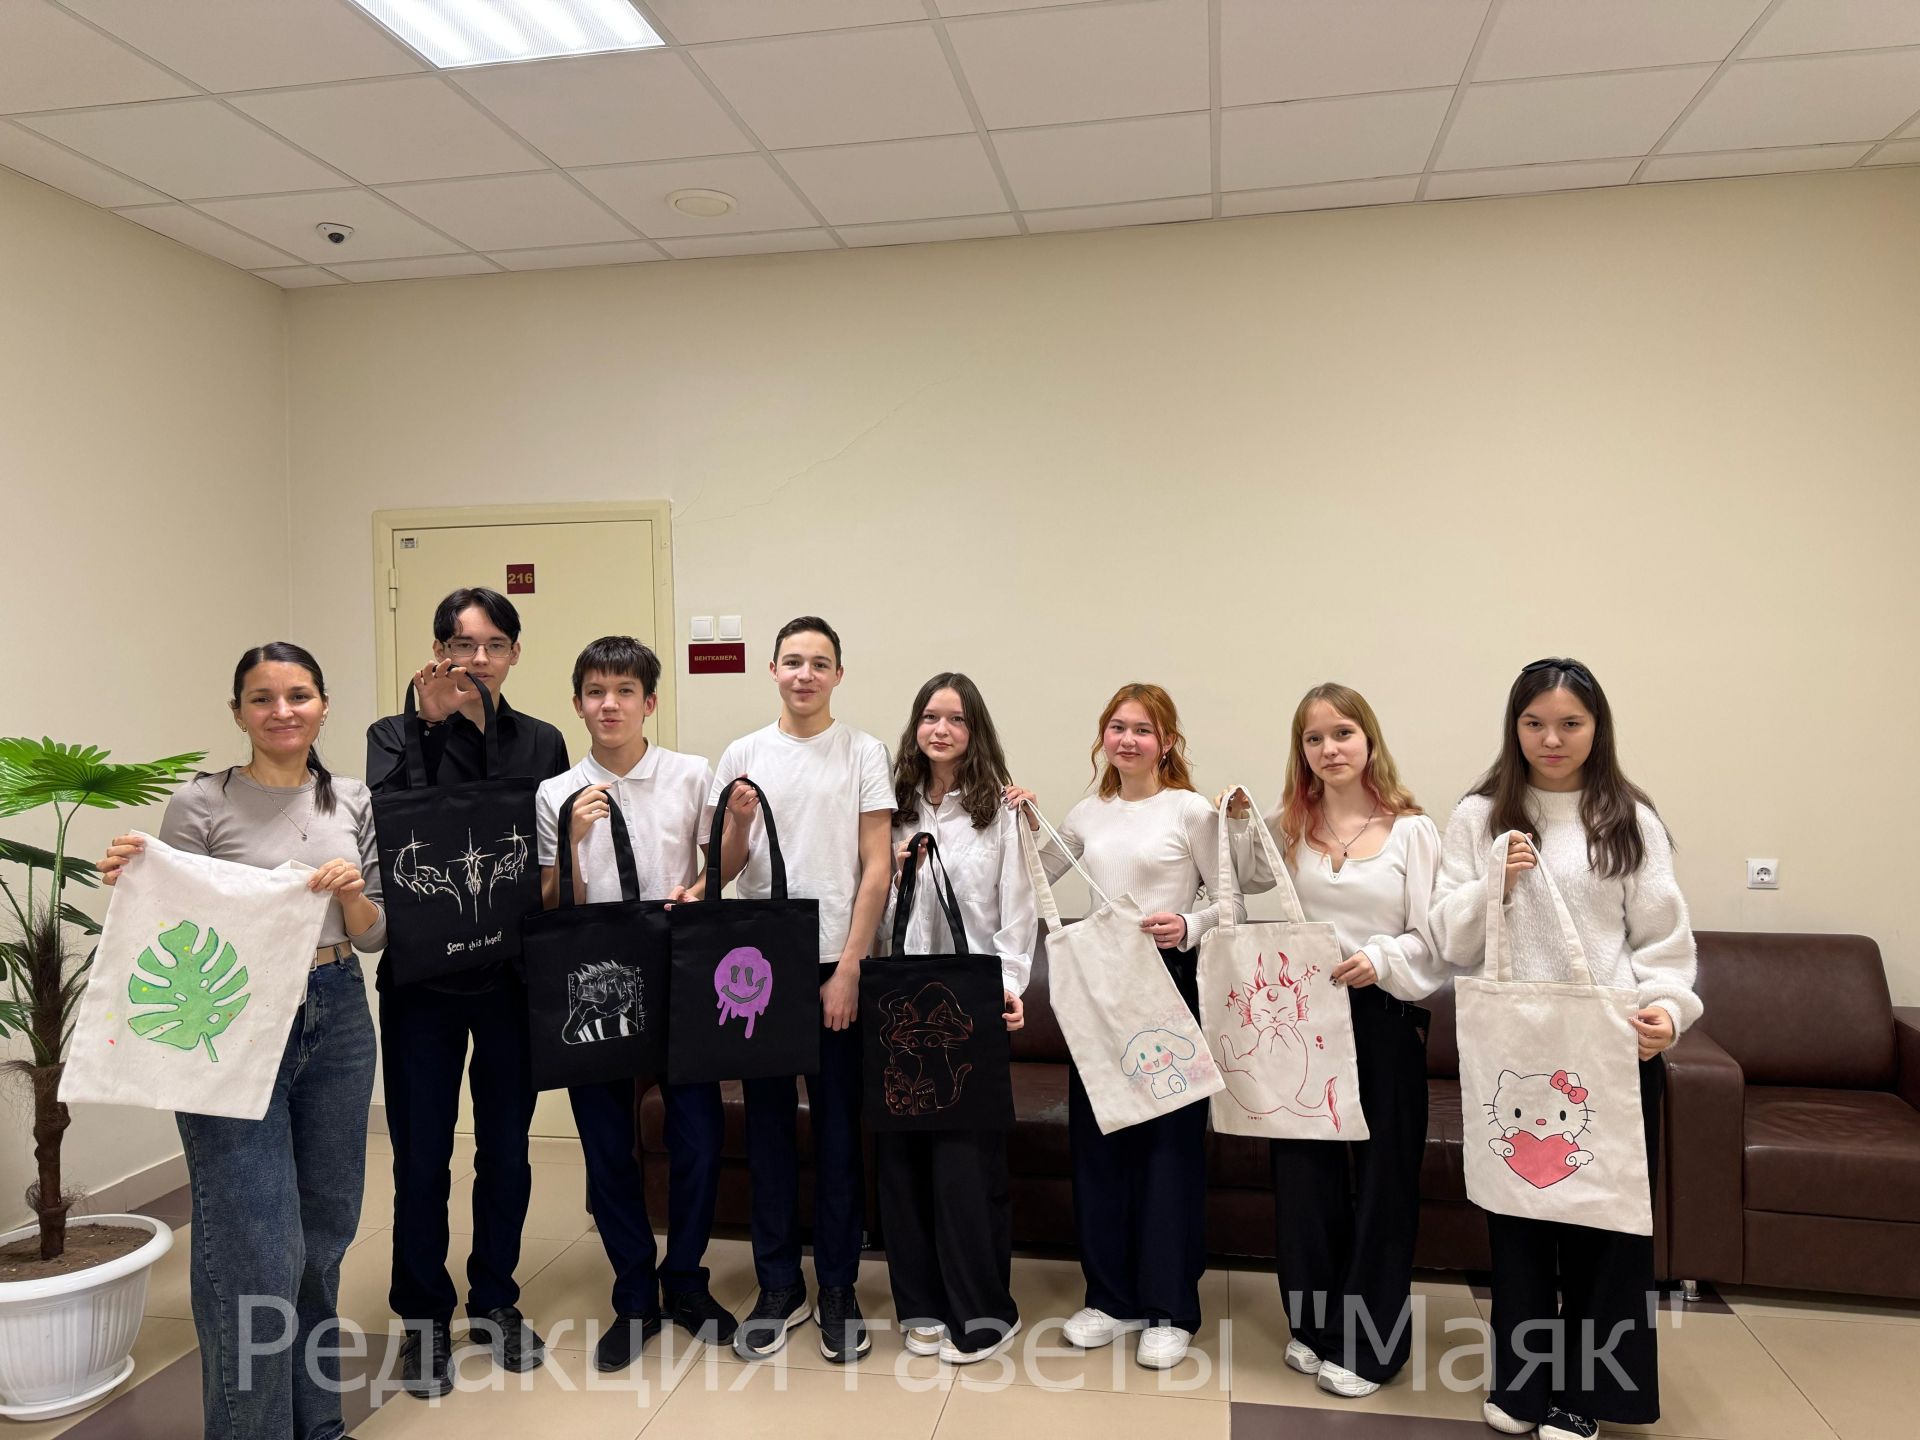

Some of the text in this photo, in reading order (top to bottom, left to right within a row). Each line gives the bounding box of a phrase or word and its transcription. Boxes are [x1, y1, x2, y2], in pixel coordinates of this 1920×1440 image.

[508, 573, 533, 584] 216
[446, 942, 465, 955] Seen
[468, 938, 482, 951] this
